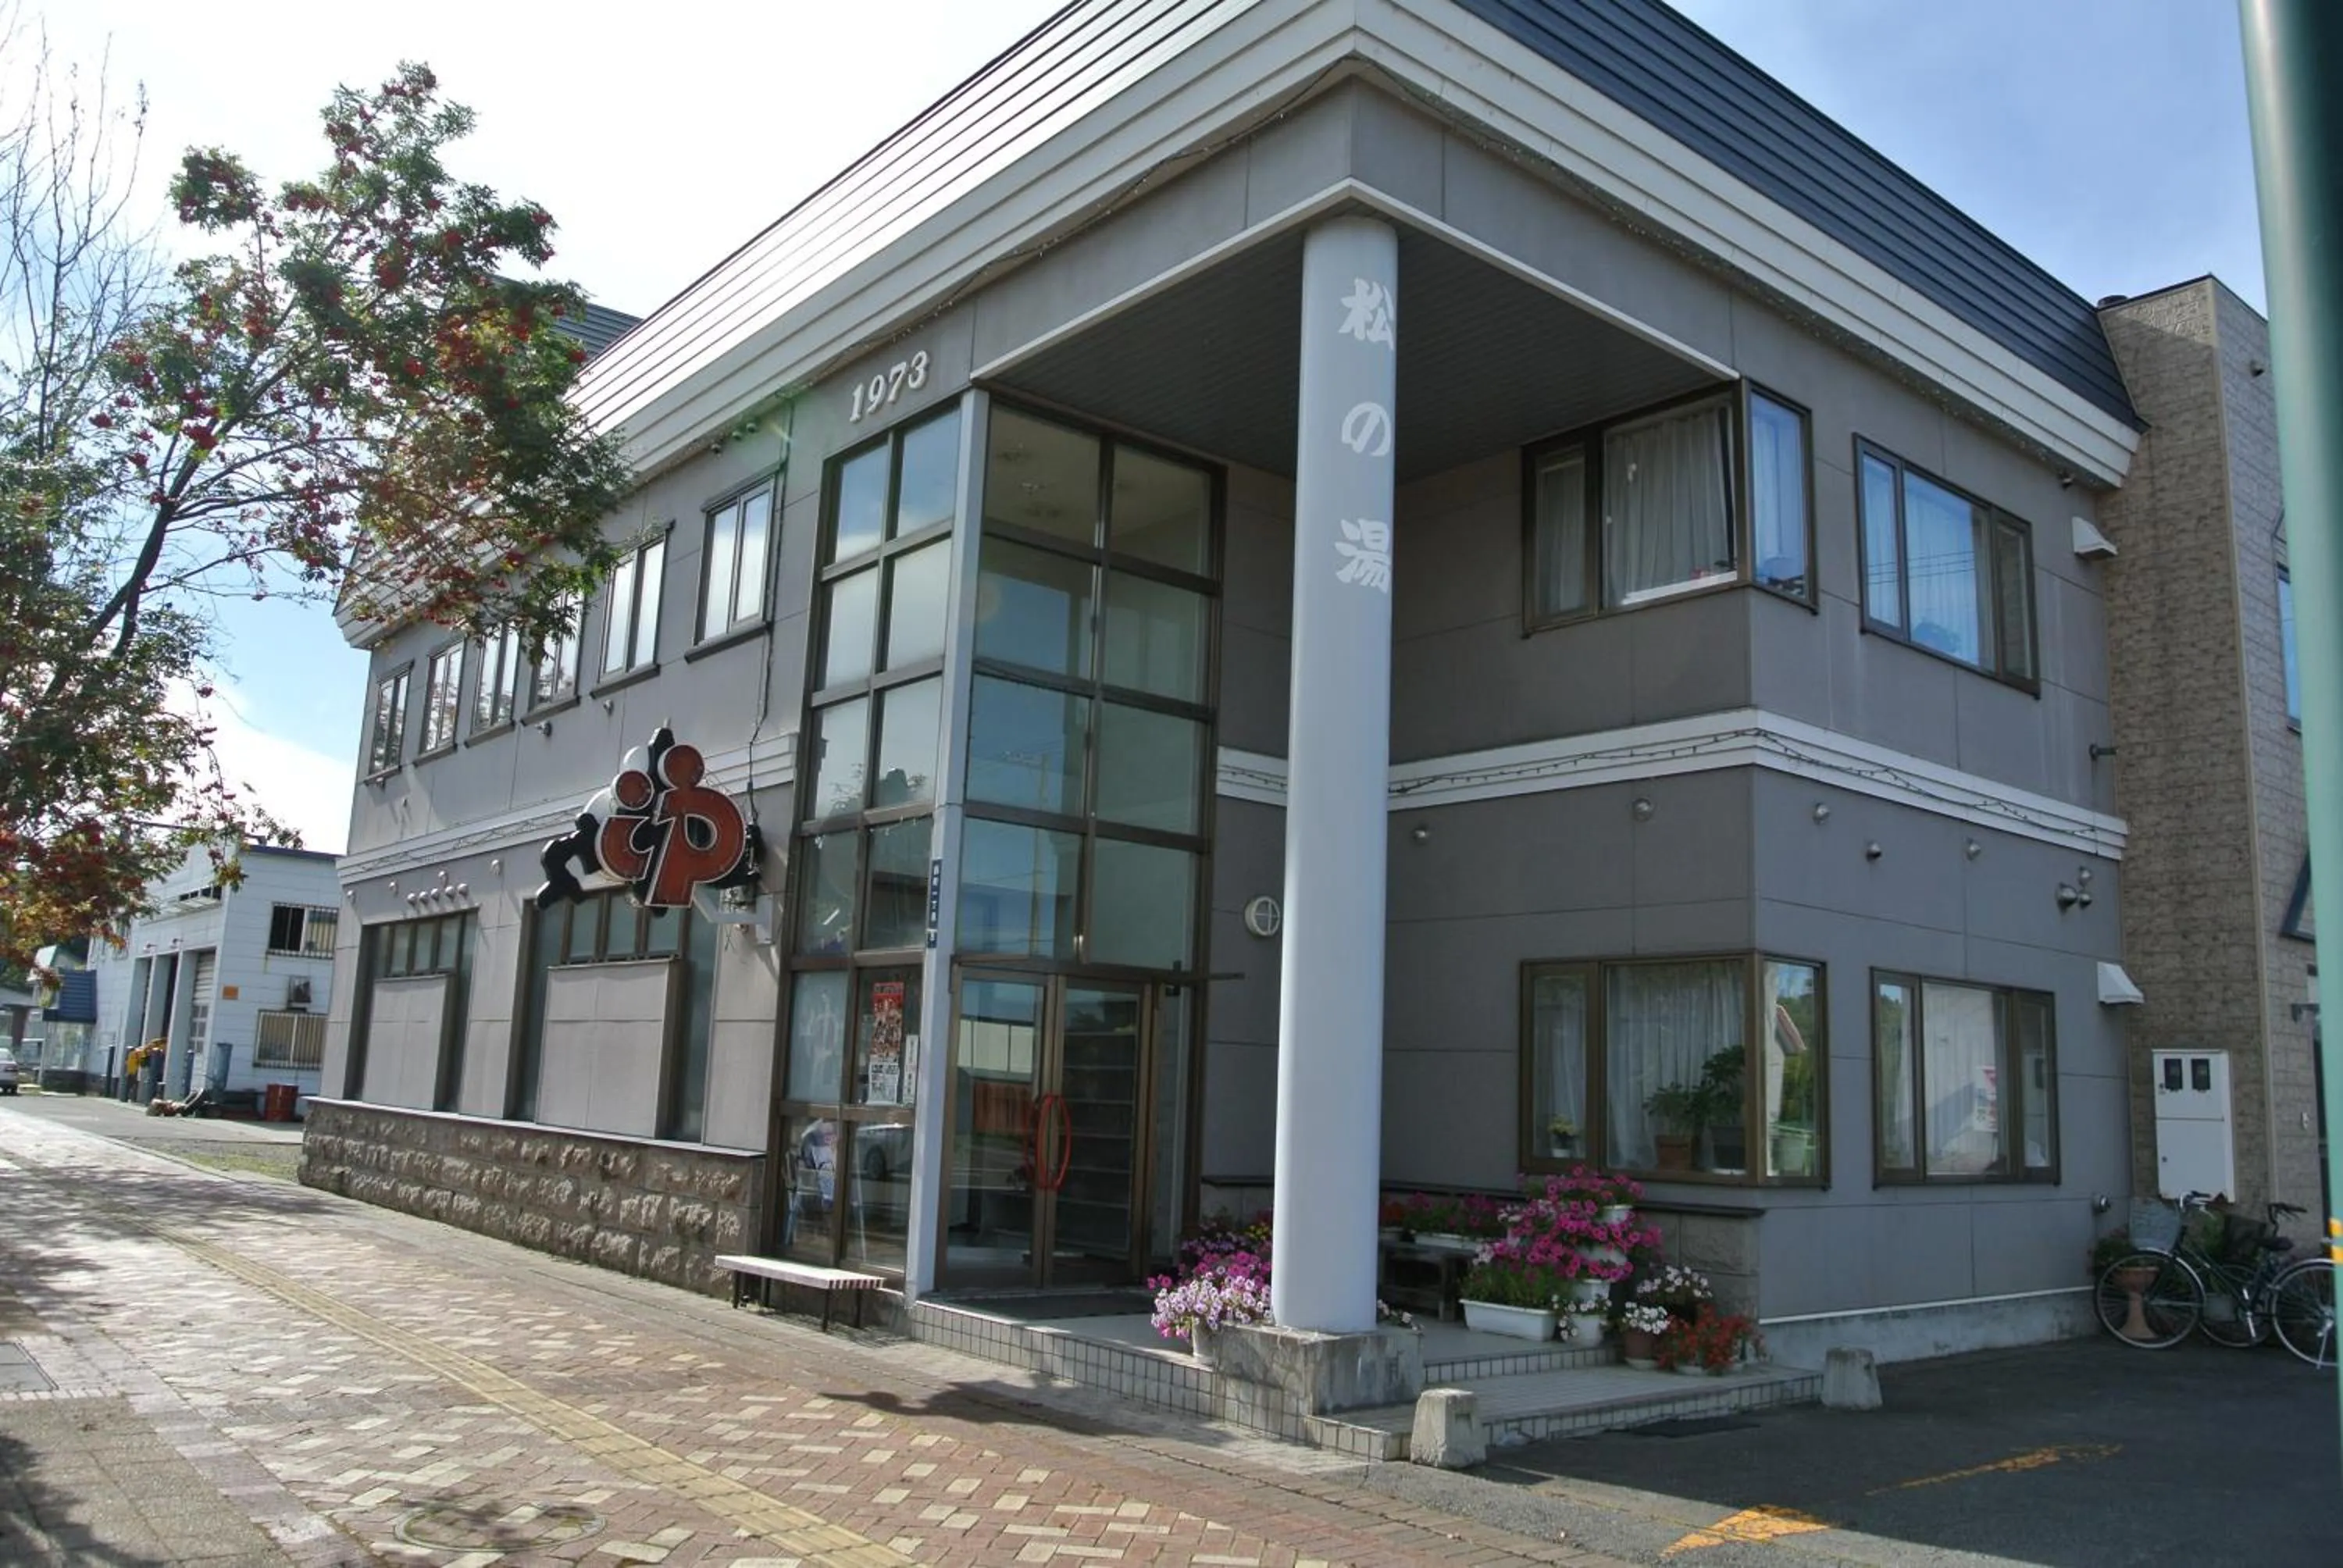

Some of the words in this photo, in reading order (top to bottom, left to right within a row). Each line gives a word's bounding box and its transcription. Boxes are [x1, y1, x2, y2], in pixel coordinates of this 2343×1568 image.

[850, 350, 928, 422] 1973
[1335, 277, 1394, 593] 松の湯
